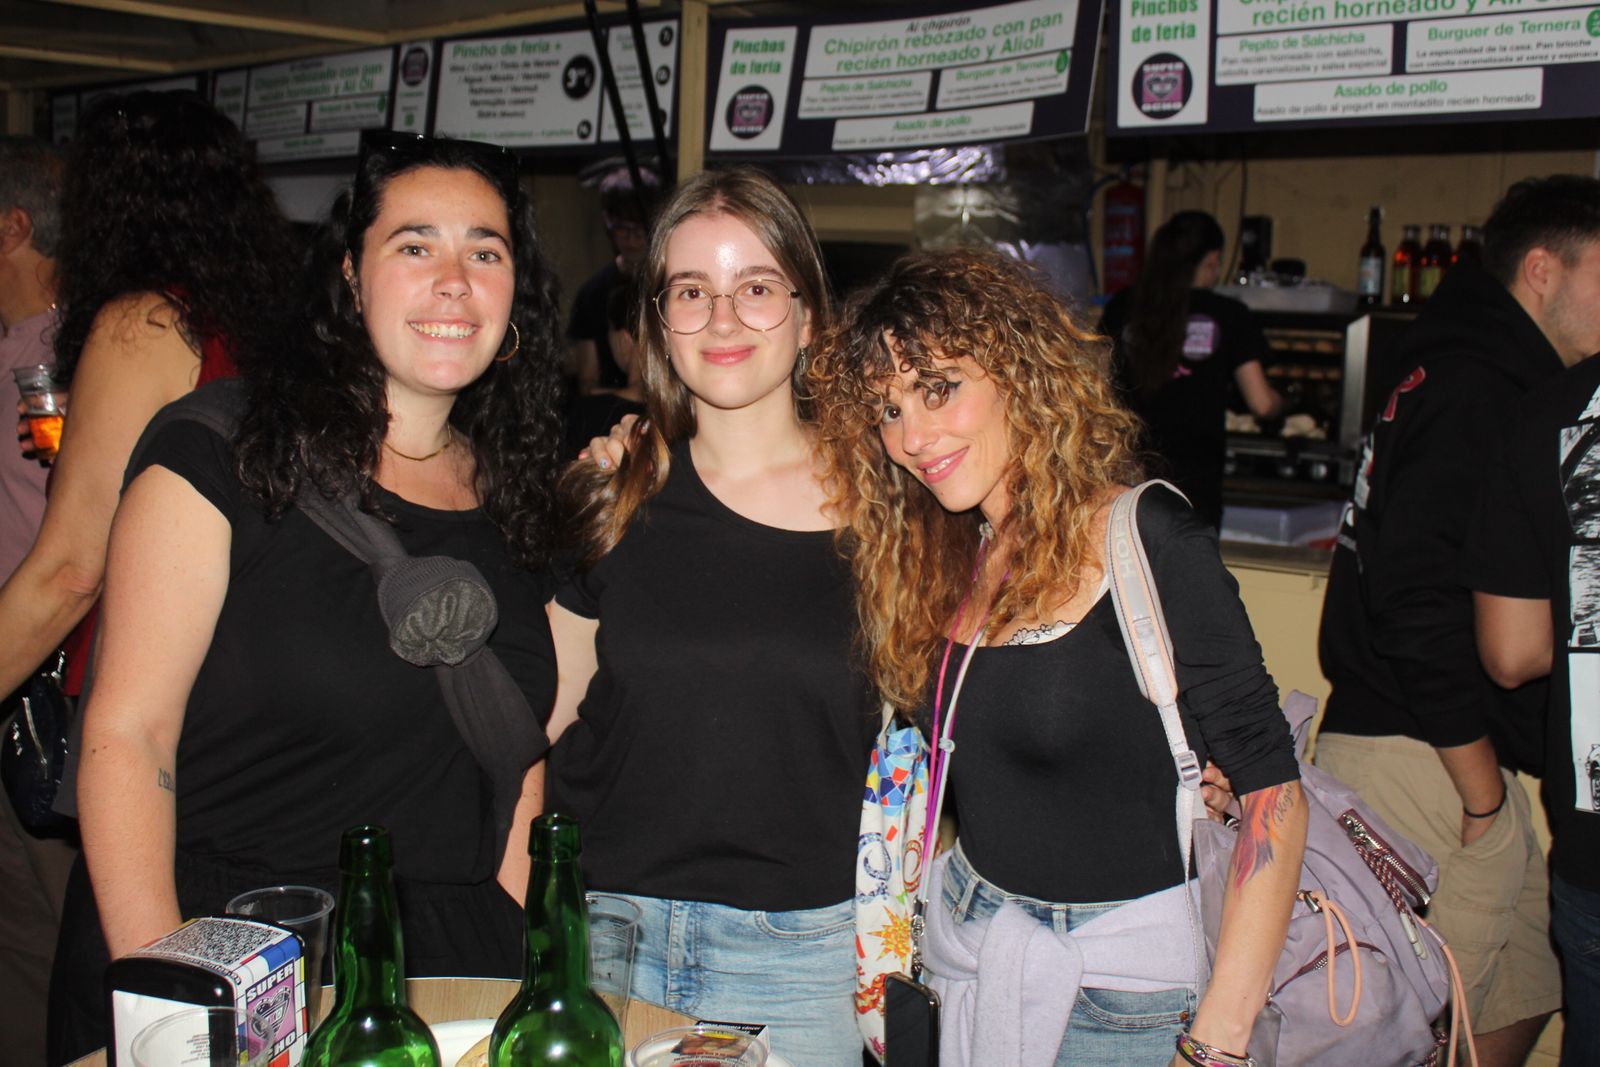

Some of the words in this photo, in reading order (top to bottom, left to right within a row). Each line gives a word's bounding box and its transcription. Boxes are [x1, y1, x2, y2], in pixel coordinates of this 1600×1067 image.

[1132, 0, 1198, 18] Pinchos
[1252, 4, 1325, 26] recién
[1466, 0, 1476, 13] y
[921, 15, 971, 32] chipirón
[1132, 26, 1152, 42] de
[1156, 22, 1196, 41] feria
[1428, 26, 1490, 42] Burguer
[1494, 22, 1514, 36] de
[1520, 18, 1581, 34] Ternera
[824, 34, 899, 58] Chipirón
[904, 23, 986, 49] rebozado
[992, 20, 1024, 38] con
[1030, 12, 1063, 33] pan
[1238, 38, 1279, 52] Pepito
[1282, 36, 1298, 48] de
[1302, 32, 1366, 48] Salchicha
[452, 42, 497, 58] Pincho
[500, 40, 518, 54] de
[520, 38, 550, 54] feria
[732, 38, 786, 54] Pinchos
[730, 60, 746, 75] de
[750, 59, 782, 75] feria
[836, 51, 891, 72] recién
[896, 44, 980, 68] horneado
[985, 42, 996, 60] y
[1334, 84, 1382, 97] Asado
[1386, 82, 1406, 95] de
[1409, 80, 1448, 96] pollo
[1482, 93, 1536, 104] horneado
[246, 962, 294, 1003] SUPER
